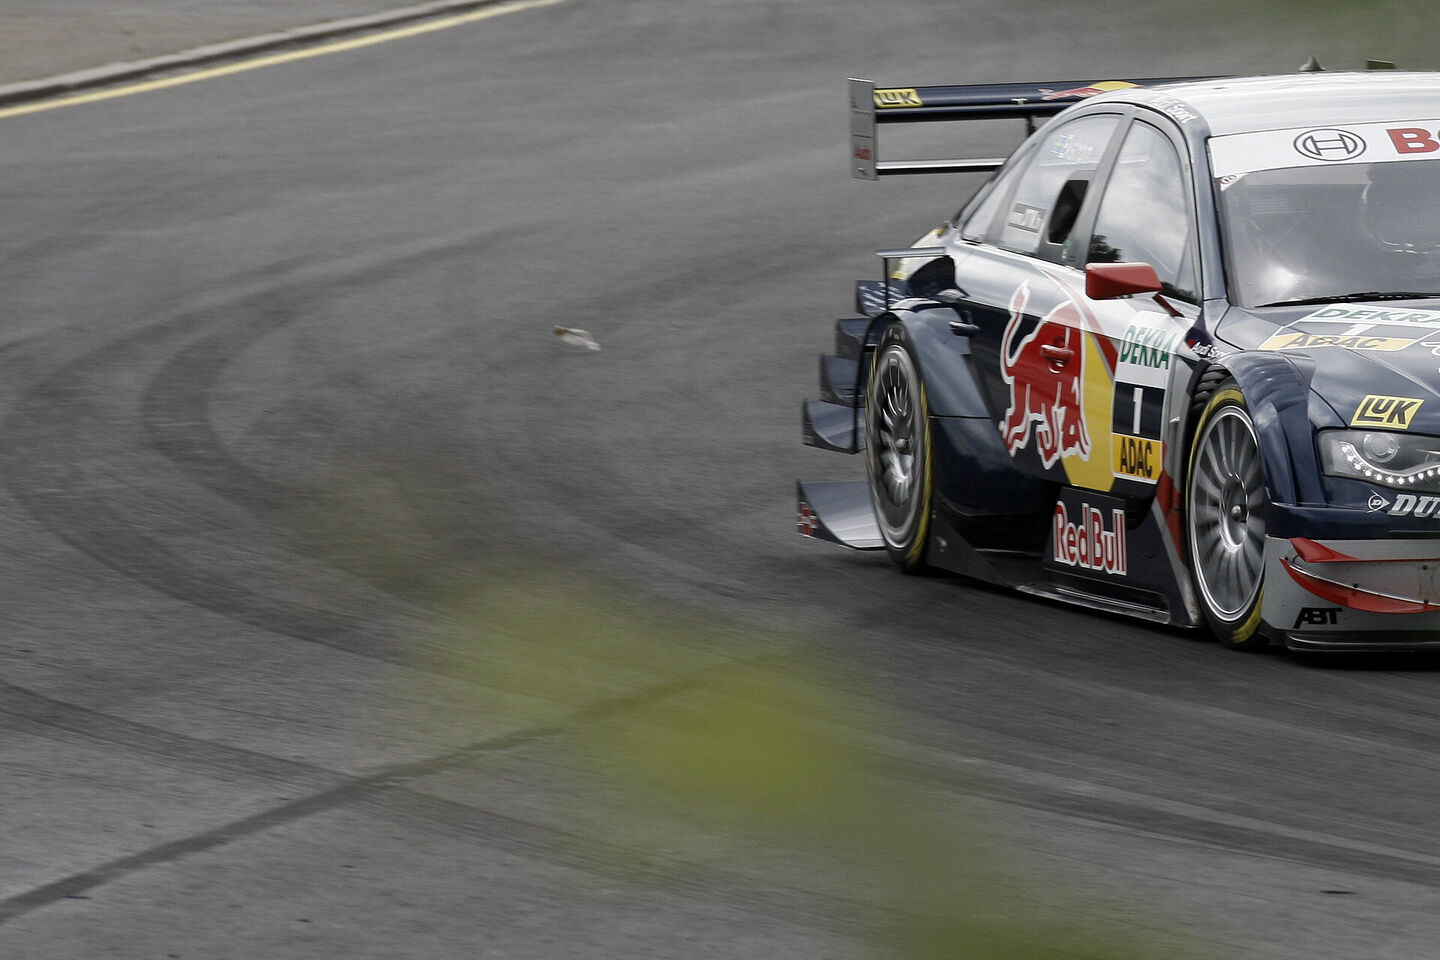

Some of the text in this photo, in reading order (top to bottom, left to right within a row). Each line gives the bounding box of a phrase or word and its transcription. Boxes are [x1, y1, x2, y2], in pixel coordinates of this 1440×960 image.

[1119, 324, 1177, 370] DEKRA
[1282, 333, 1389, 350] ADAC
[1132, 387, 1144, 435] 1
[1119, 437, 1153, 479] ADAC
[1053, 501, 1127, 576] Red Bull
[1293, 607, 1343, 630] ABT
